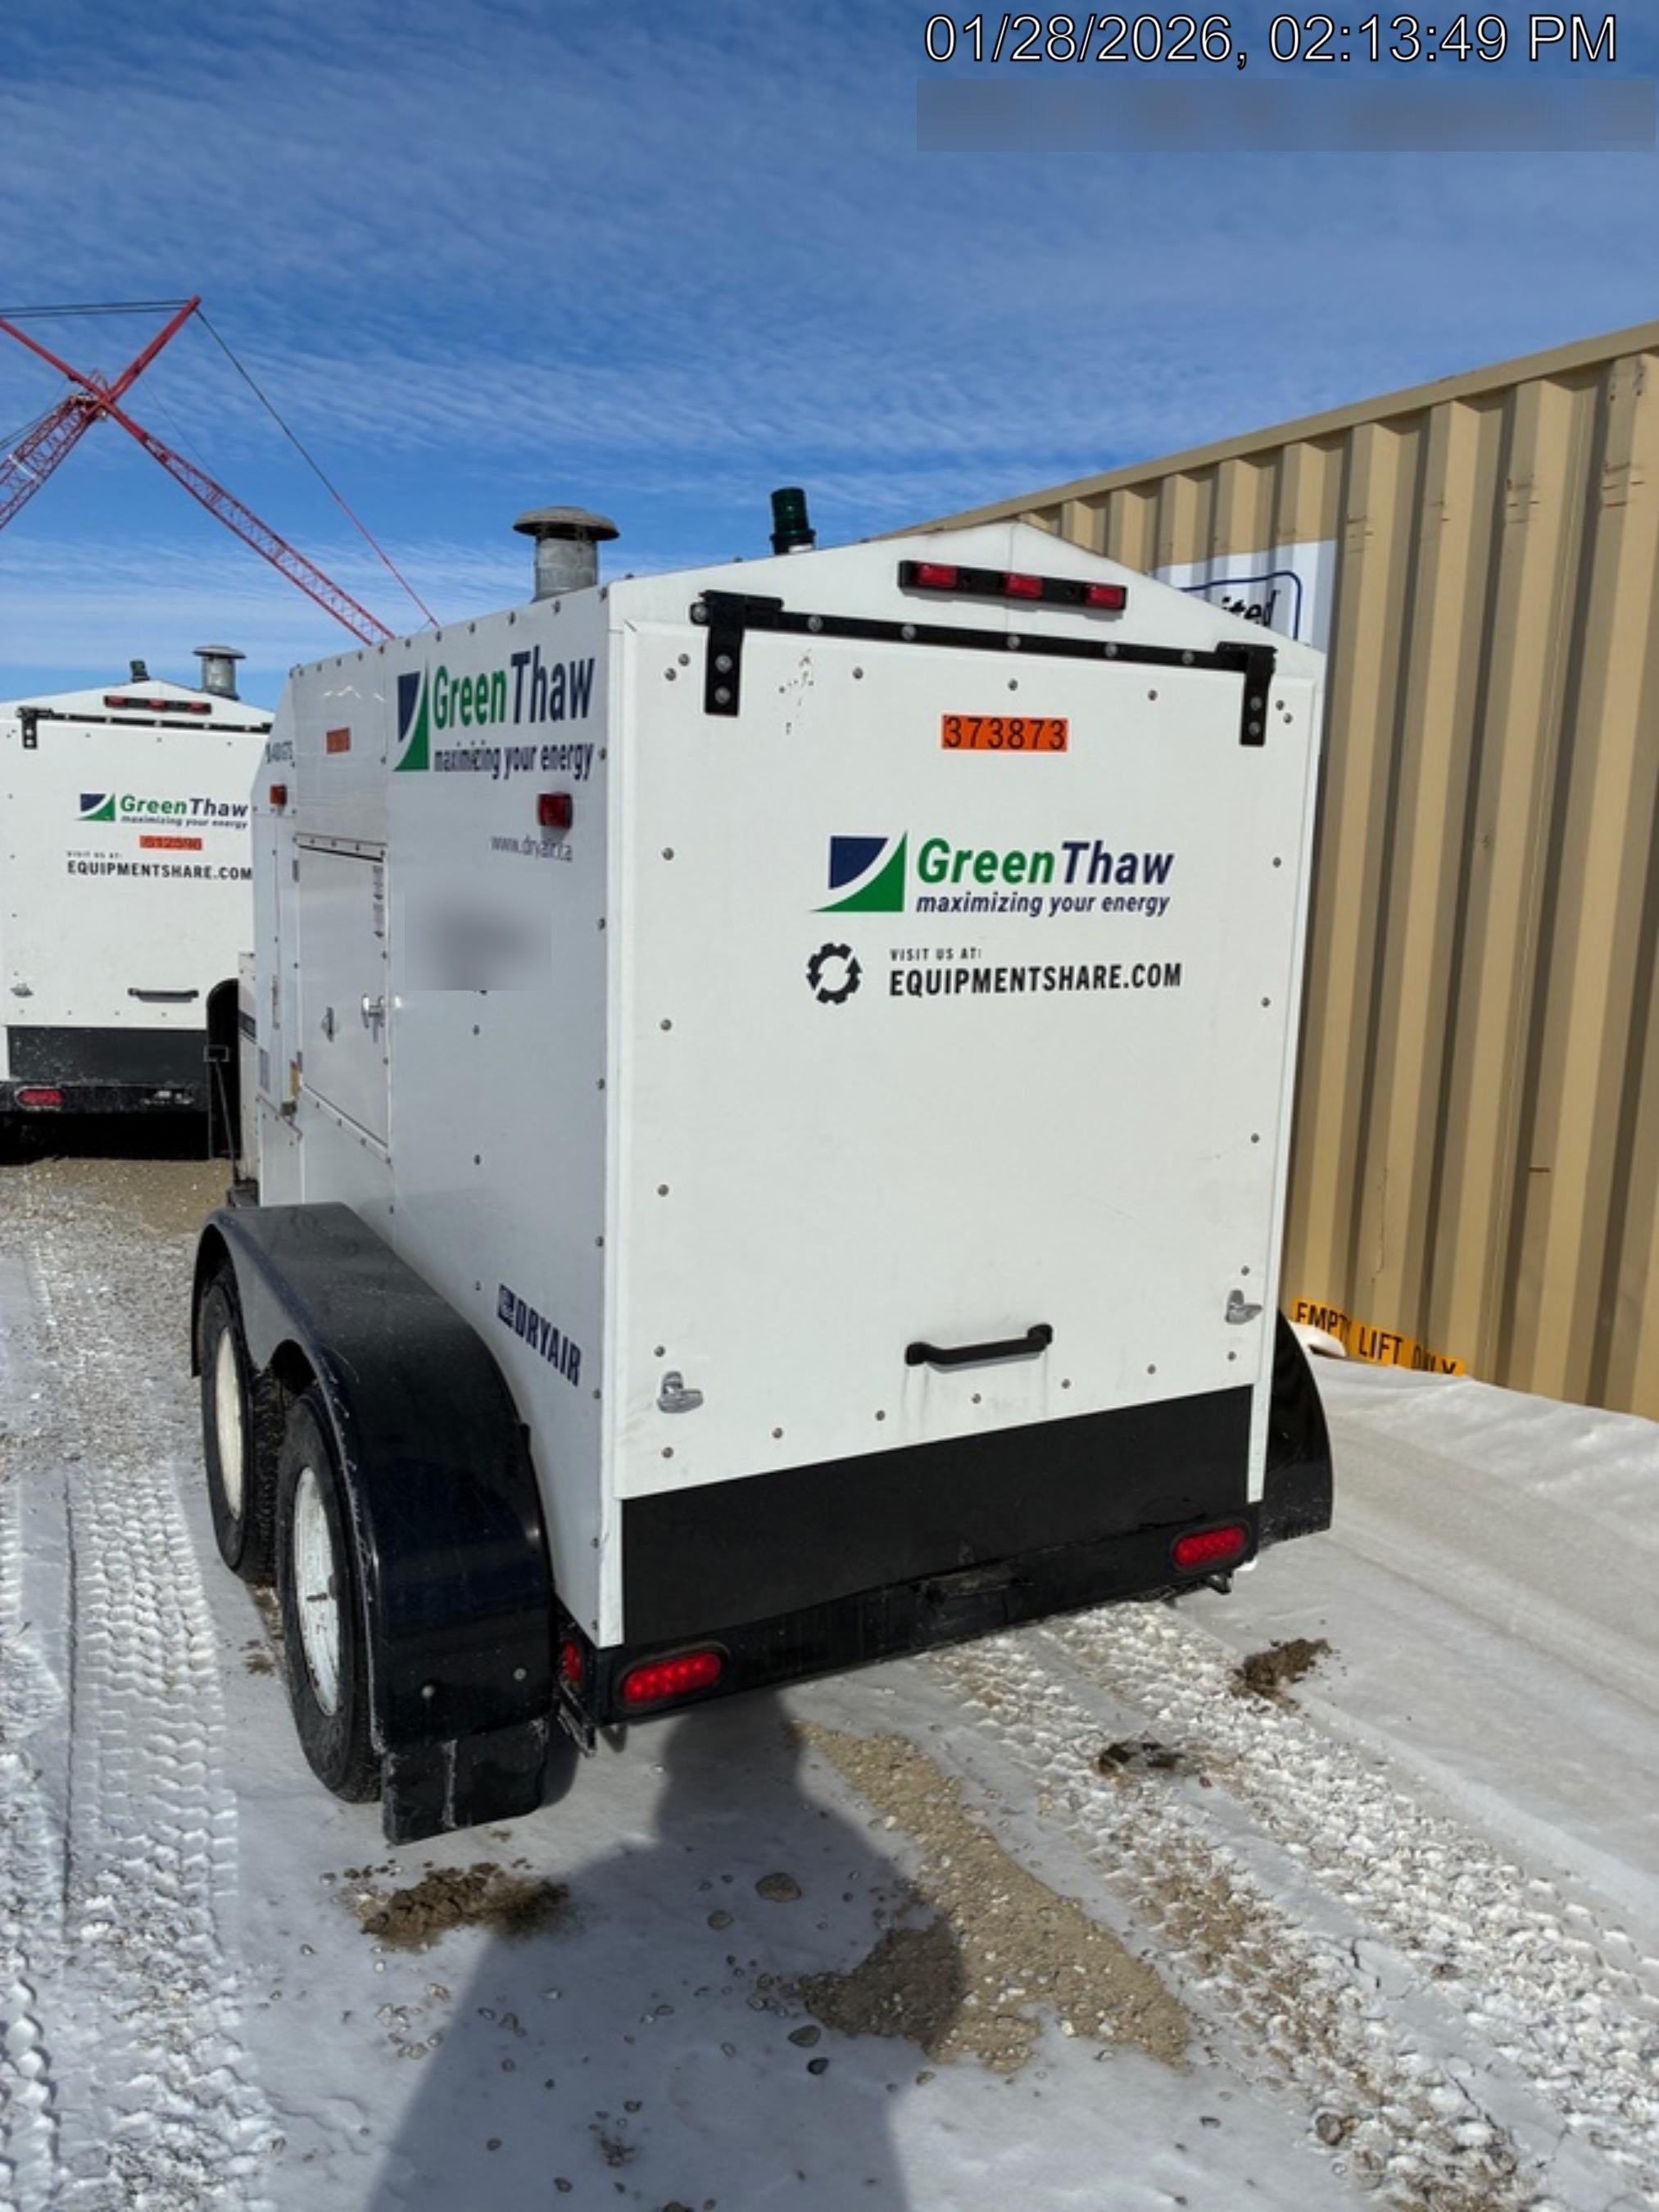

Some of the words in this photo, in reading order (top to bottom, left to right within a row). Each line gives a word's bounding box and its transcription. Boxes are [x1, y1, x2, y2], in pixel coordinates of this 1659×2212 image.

[944, 716, 1067, 751] 373873
[434, 739, 501, 780] maximizing
[503, 745, 537, 780] your
[540, 742, 595, 781] energy
[67, 860, 253, 881] EQUIPMENTSHARE.COM
[916, 836, 1175, 886] GreenThaw
[916, 891, 1043, 918] maximizing
[1048, 895, 1097, 918] your
[1101, 895, 1171, 918] energy
[890, 948, 930, 961] VISIT
[936, 948, 954, 960] US
[959, 947, 982, 959] AT:
[889, 963, 1182, 999] EQUIPMENTSHARE.COM
[1358, 1326, 1403, 1365] LIFT
